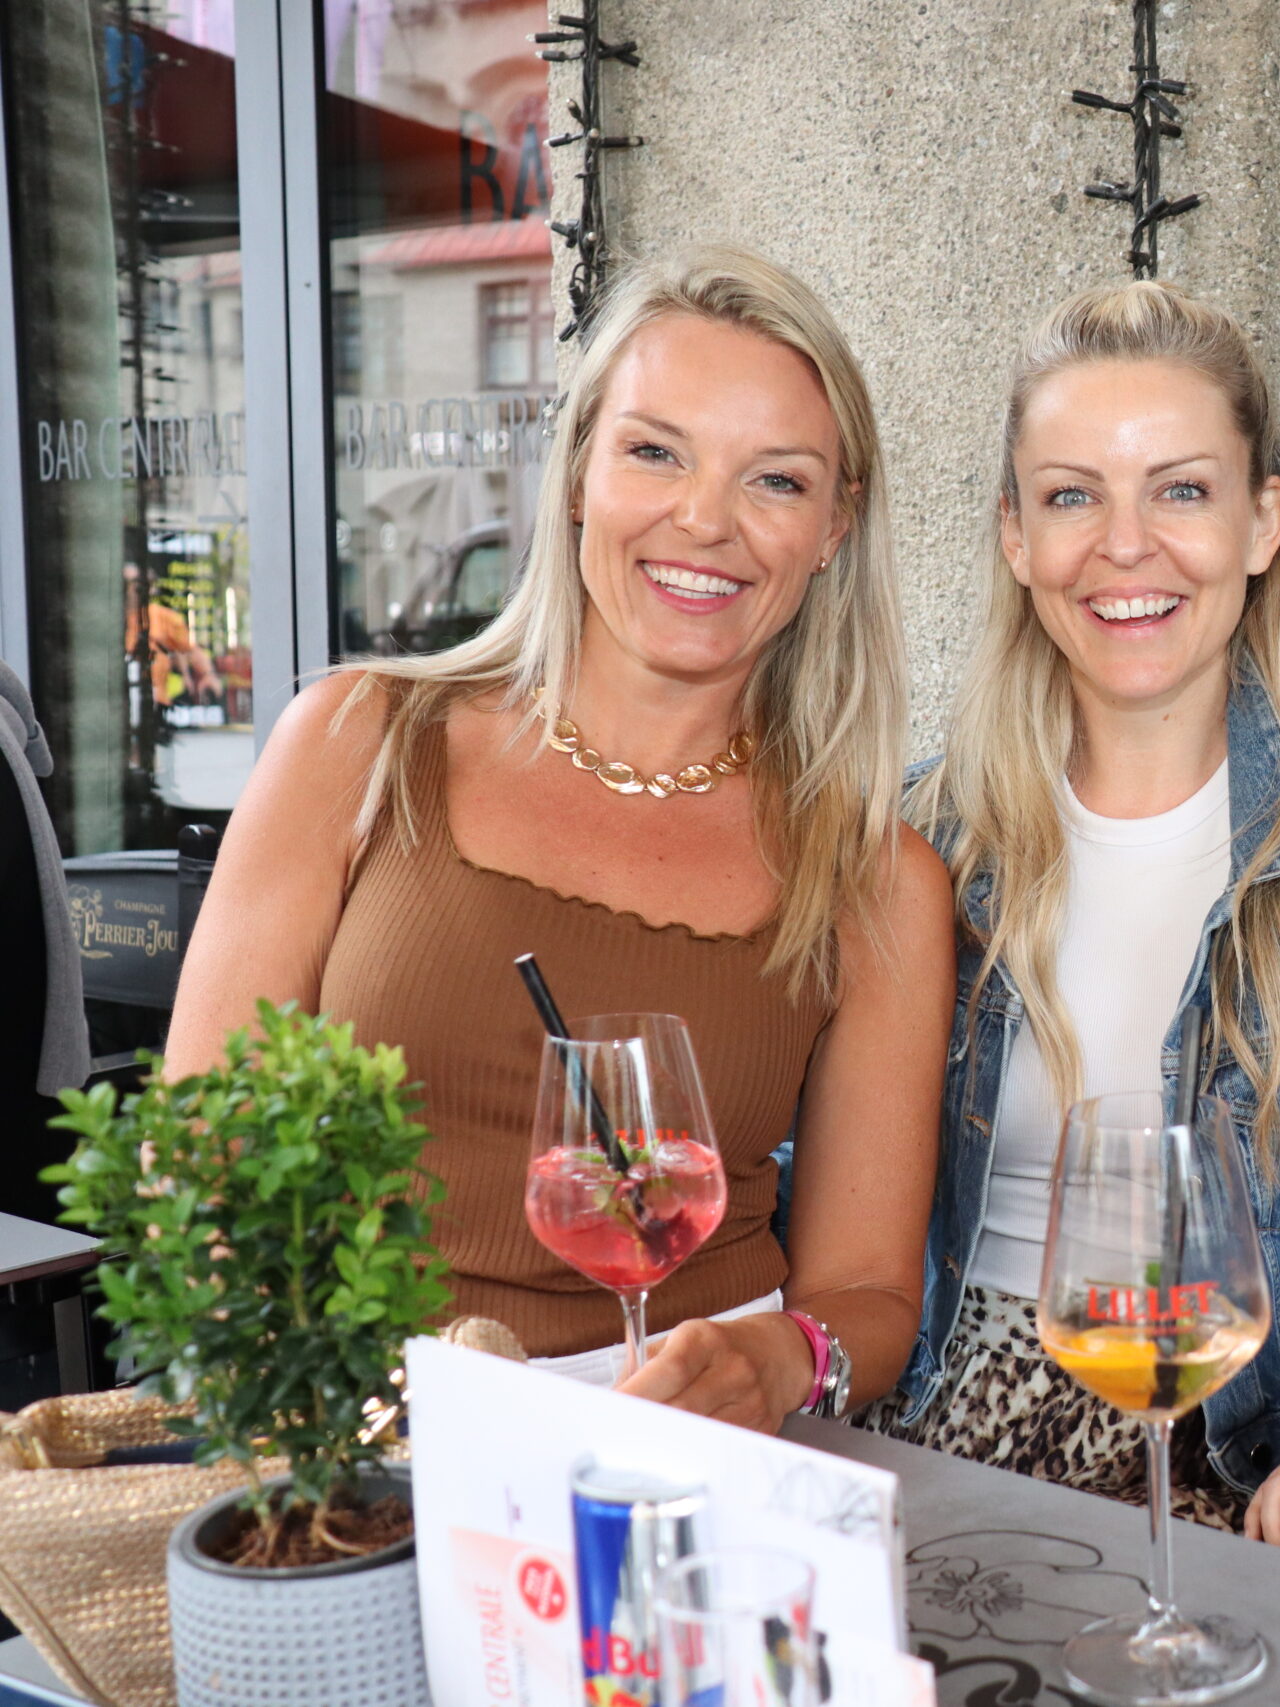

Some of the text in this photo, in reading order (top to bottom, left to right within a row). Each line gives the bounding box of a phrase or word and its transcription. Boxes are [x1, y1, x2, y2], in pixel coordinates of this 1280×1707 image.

[37, 411, 247, 483] BAR CENTRALE
[346, 399, 412, 470] BAR
[114, 899, 167, 916] CHAMPAGNE
[1087, 1280, 1220, 1321] LILLET
